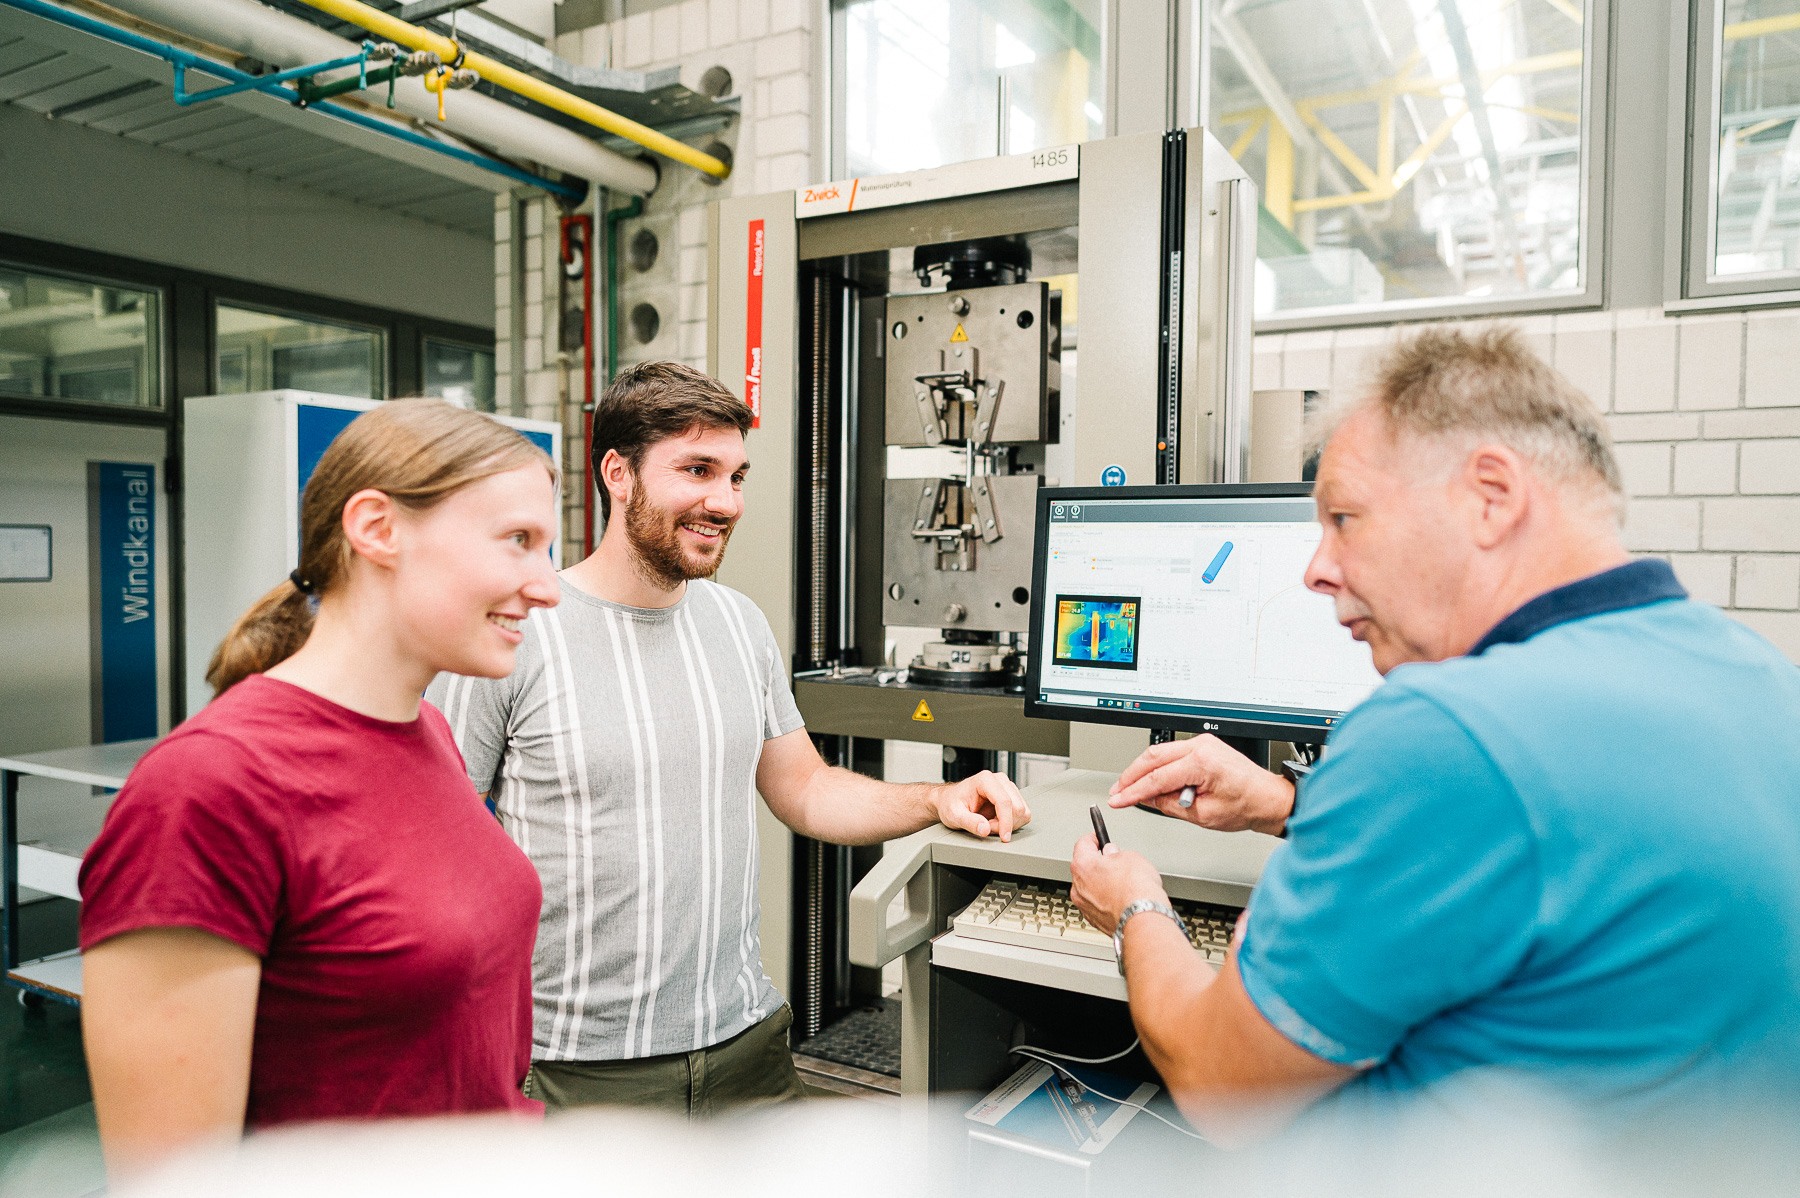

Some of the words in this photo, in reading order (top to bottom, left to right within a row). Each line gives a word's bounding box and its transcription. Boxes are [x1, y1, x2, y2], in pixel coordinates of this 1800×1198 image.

[1031, 149, 1069, 169] 1485
[803, 187, 840, 203] Zwick
[753, 229, 764, 276] RetroLine
[122, 470, 150, 624] Windkanal
